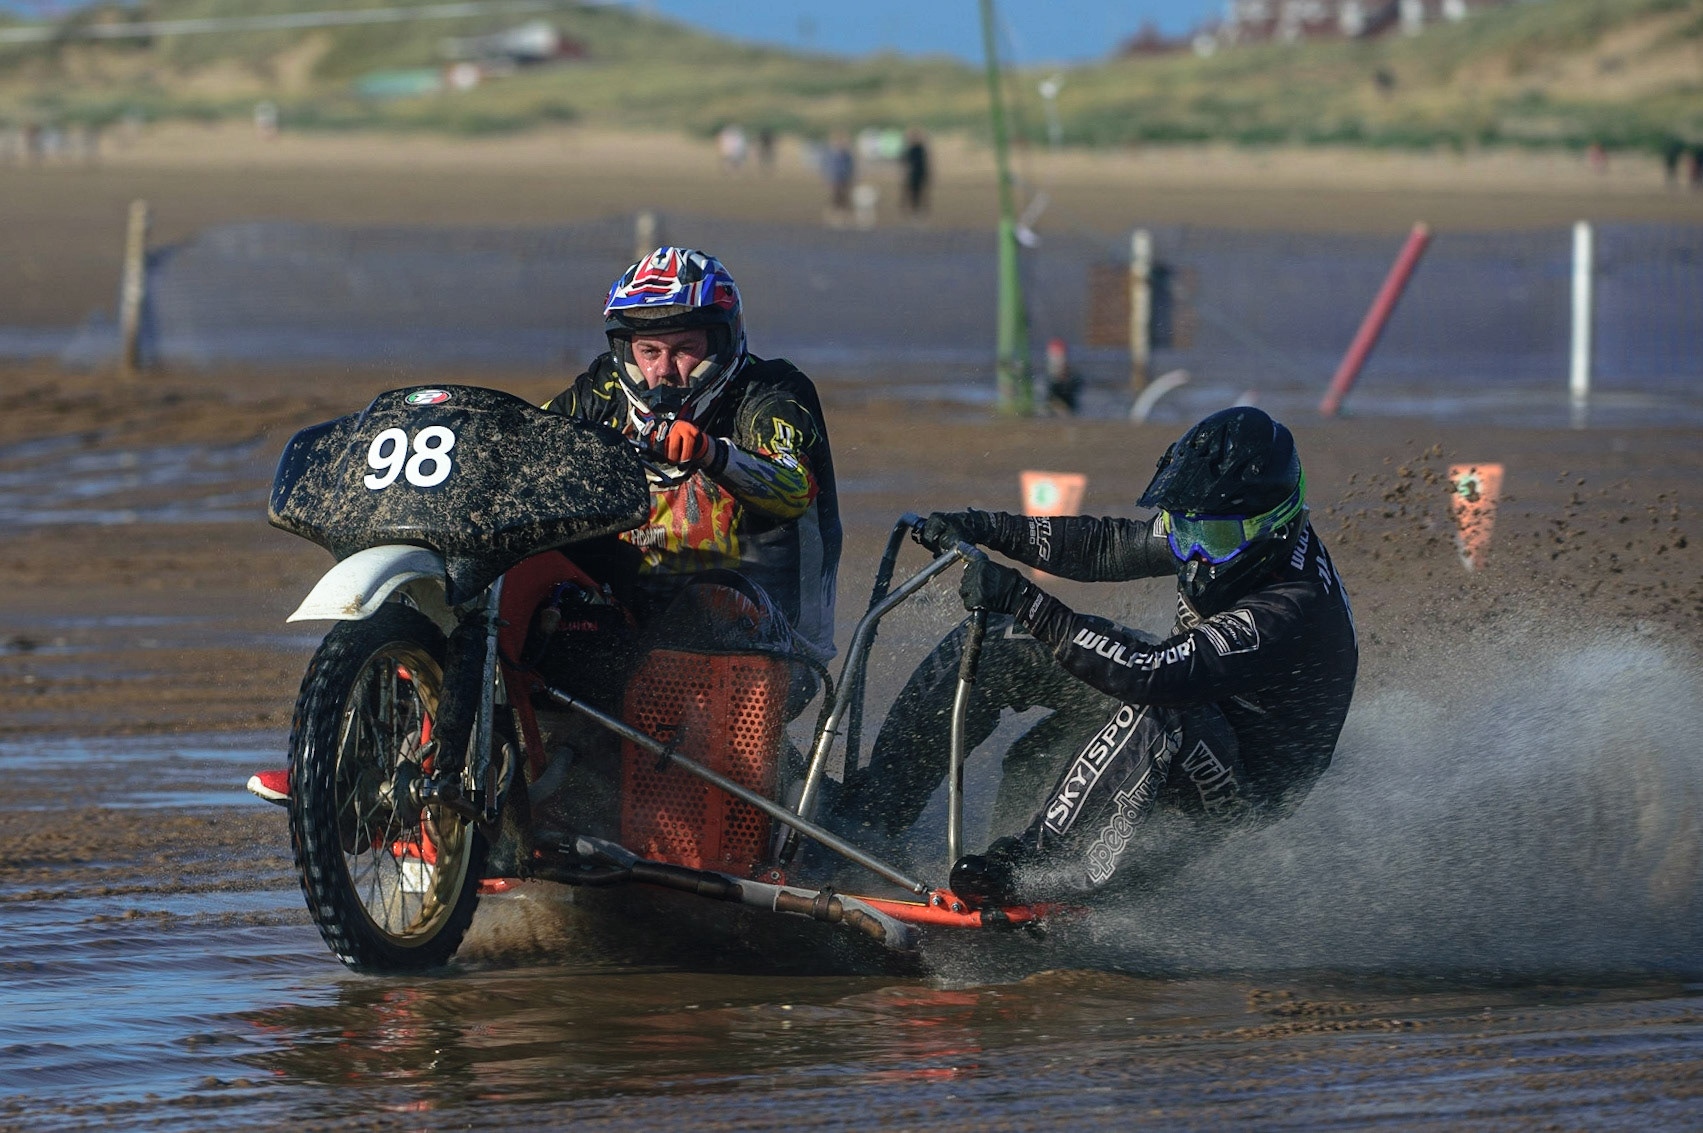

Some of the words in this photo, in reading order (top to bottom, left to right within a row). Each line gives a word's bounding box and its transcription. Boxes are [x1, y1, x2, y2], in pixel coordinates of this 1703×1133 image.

[363, 425, 456, 490] 98
[1046, 764, 1087, 827] SKY
[1088, 703, 1140, 766] SPO
